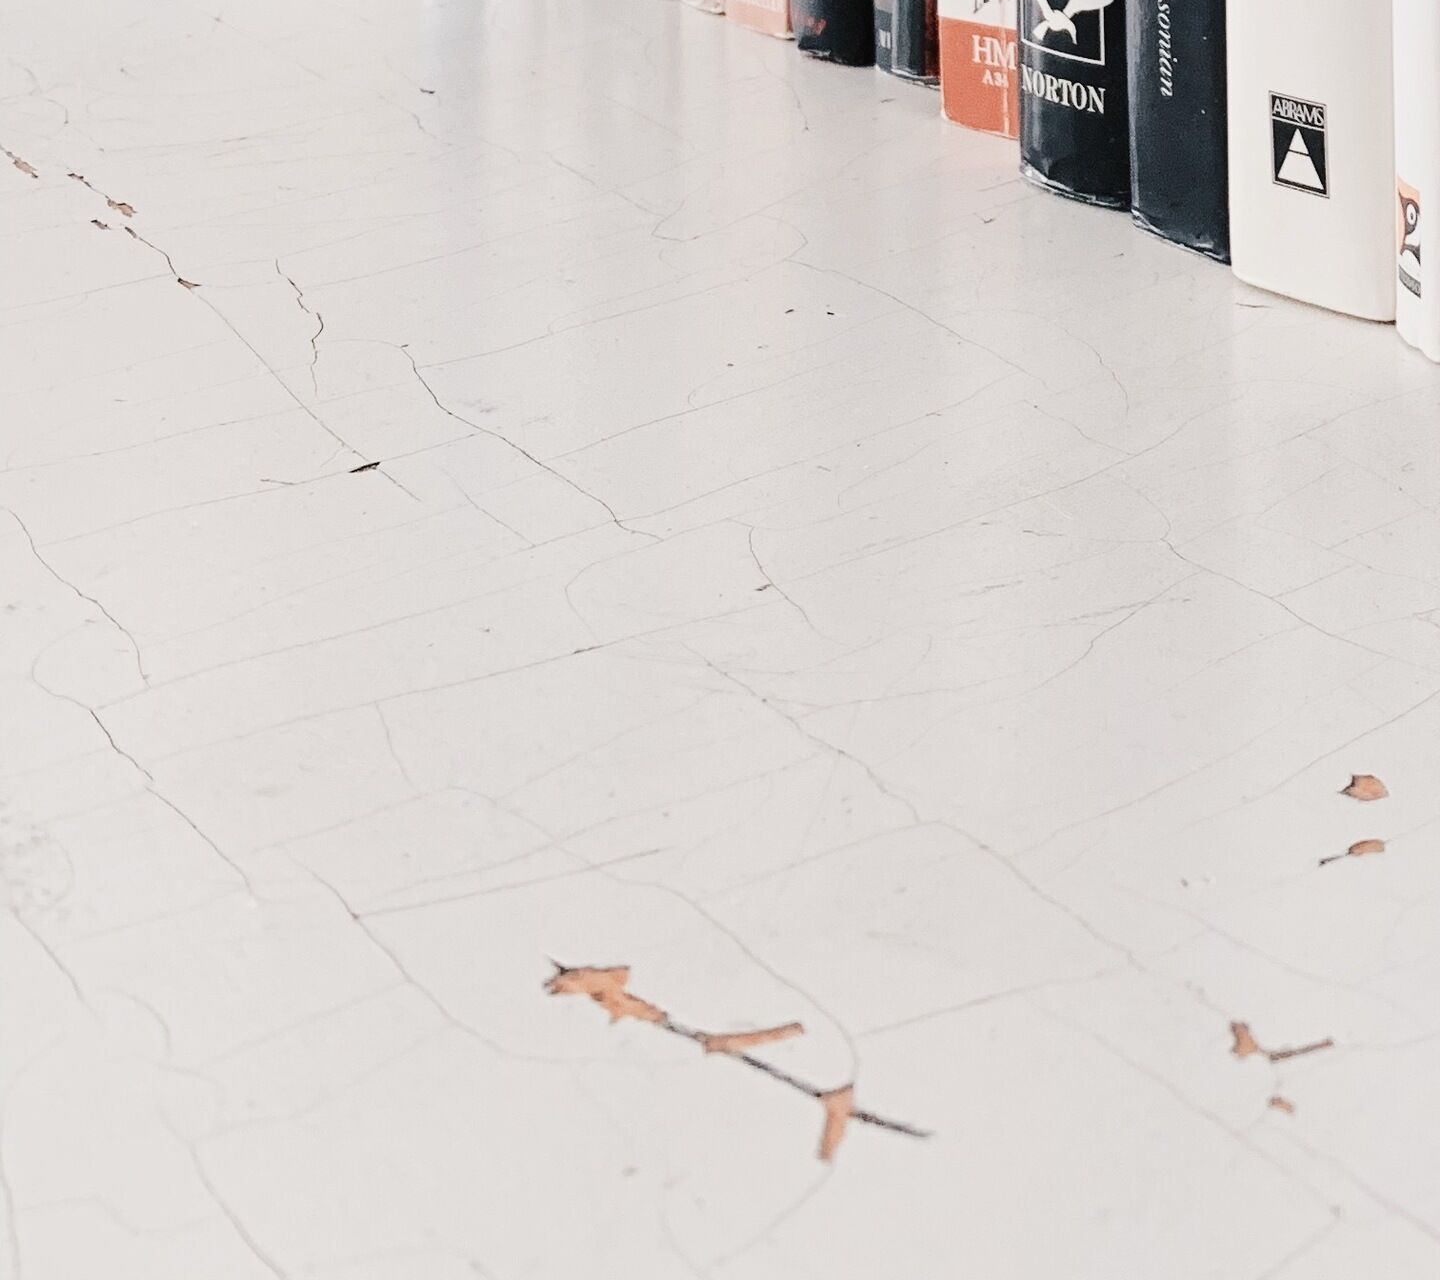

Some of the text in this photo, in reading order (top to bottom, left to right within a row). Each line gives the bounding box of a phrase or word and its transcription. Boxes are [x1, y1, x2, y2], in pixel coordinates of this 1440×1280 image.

[971, 34, 1017, 70] HM
[1021, 63, 1106, 114] NORTON
[1272, 98, 1325, 126] ABRAMS
